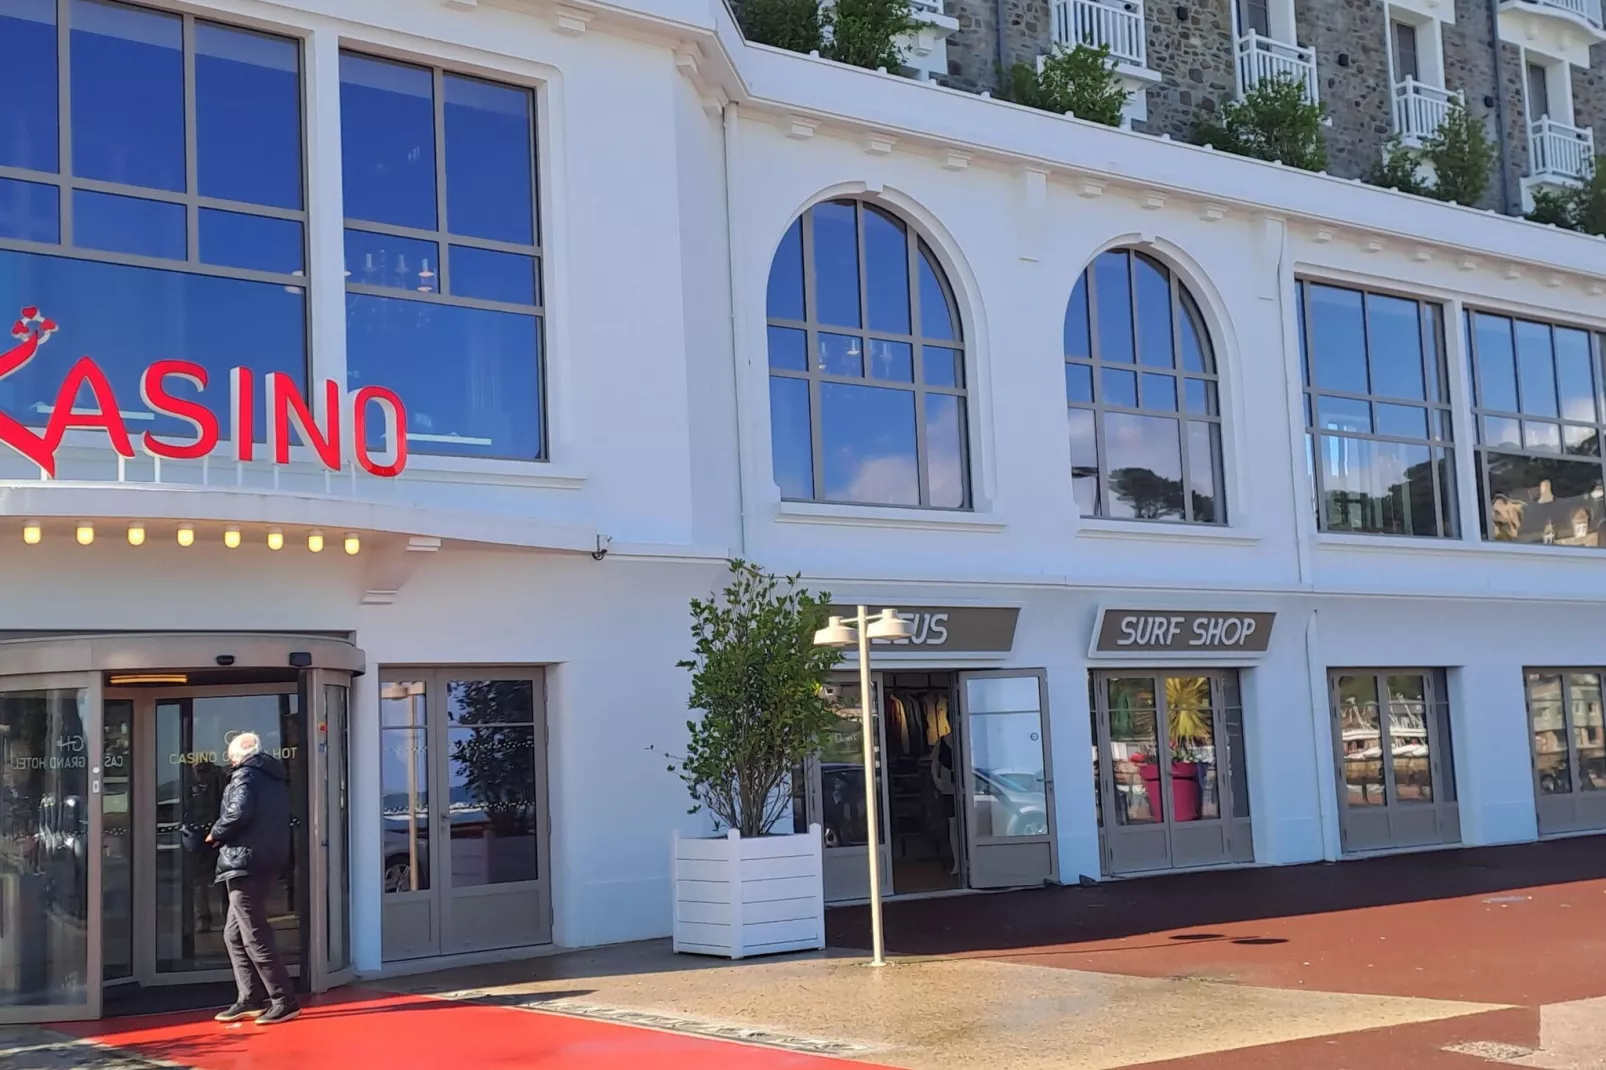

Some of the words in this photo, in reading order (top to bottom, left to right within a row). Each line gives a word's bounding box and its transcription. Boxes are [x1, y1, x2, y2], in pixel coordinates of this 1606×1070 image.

[1117, 616, 1185, 646] SURF
[1189, 617, 1256, 646] SHOP
[168, 751, 218, 765] CASINO
